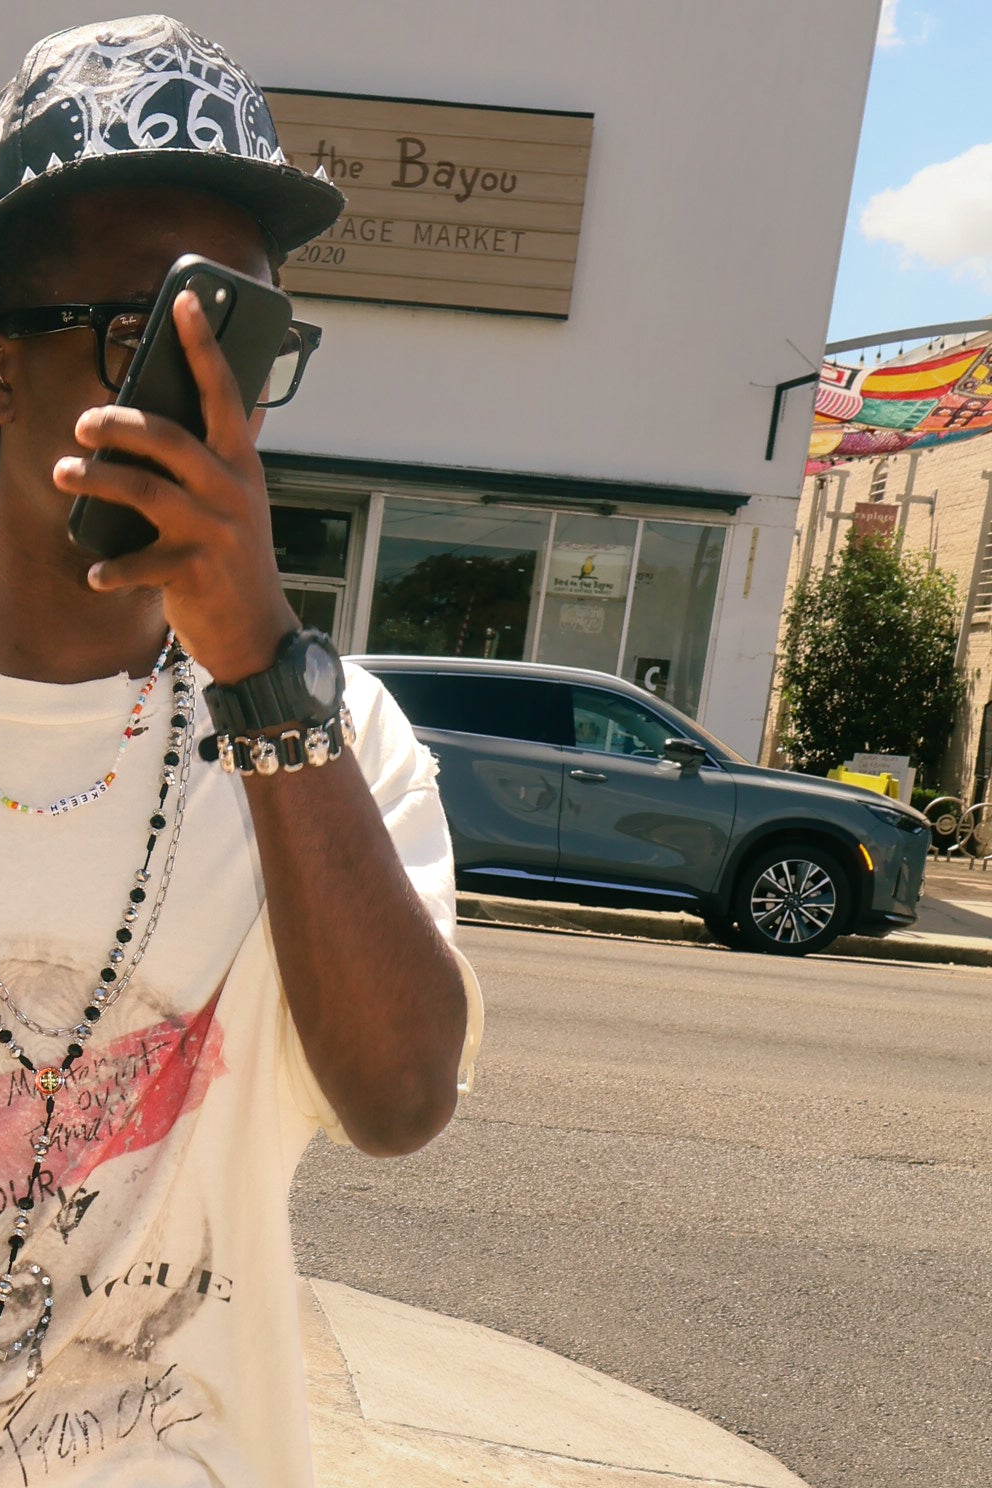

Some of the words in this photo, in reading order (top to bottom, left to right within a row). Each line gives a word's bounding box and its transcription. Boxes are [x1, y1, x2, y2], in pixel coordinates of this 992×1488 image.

[127, 78, 223, 149] 66
[310, 139, 364, 180] the
[392, 137, 517, 203] Bayou
[413, 222, 526, 253] MARKET
[296, 244, 345, 265] 2020
[855, 511, 895, 522] explore
